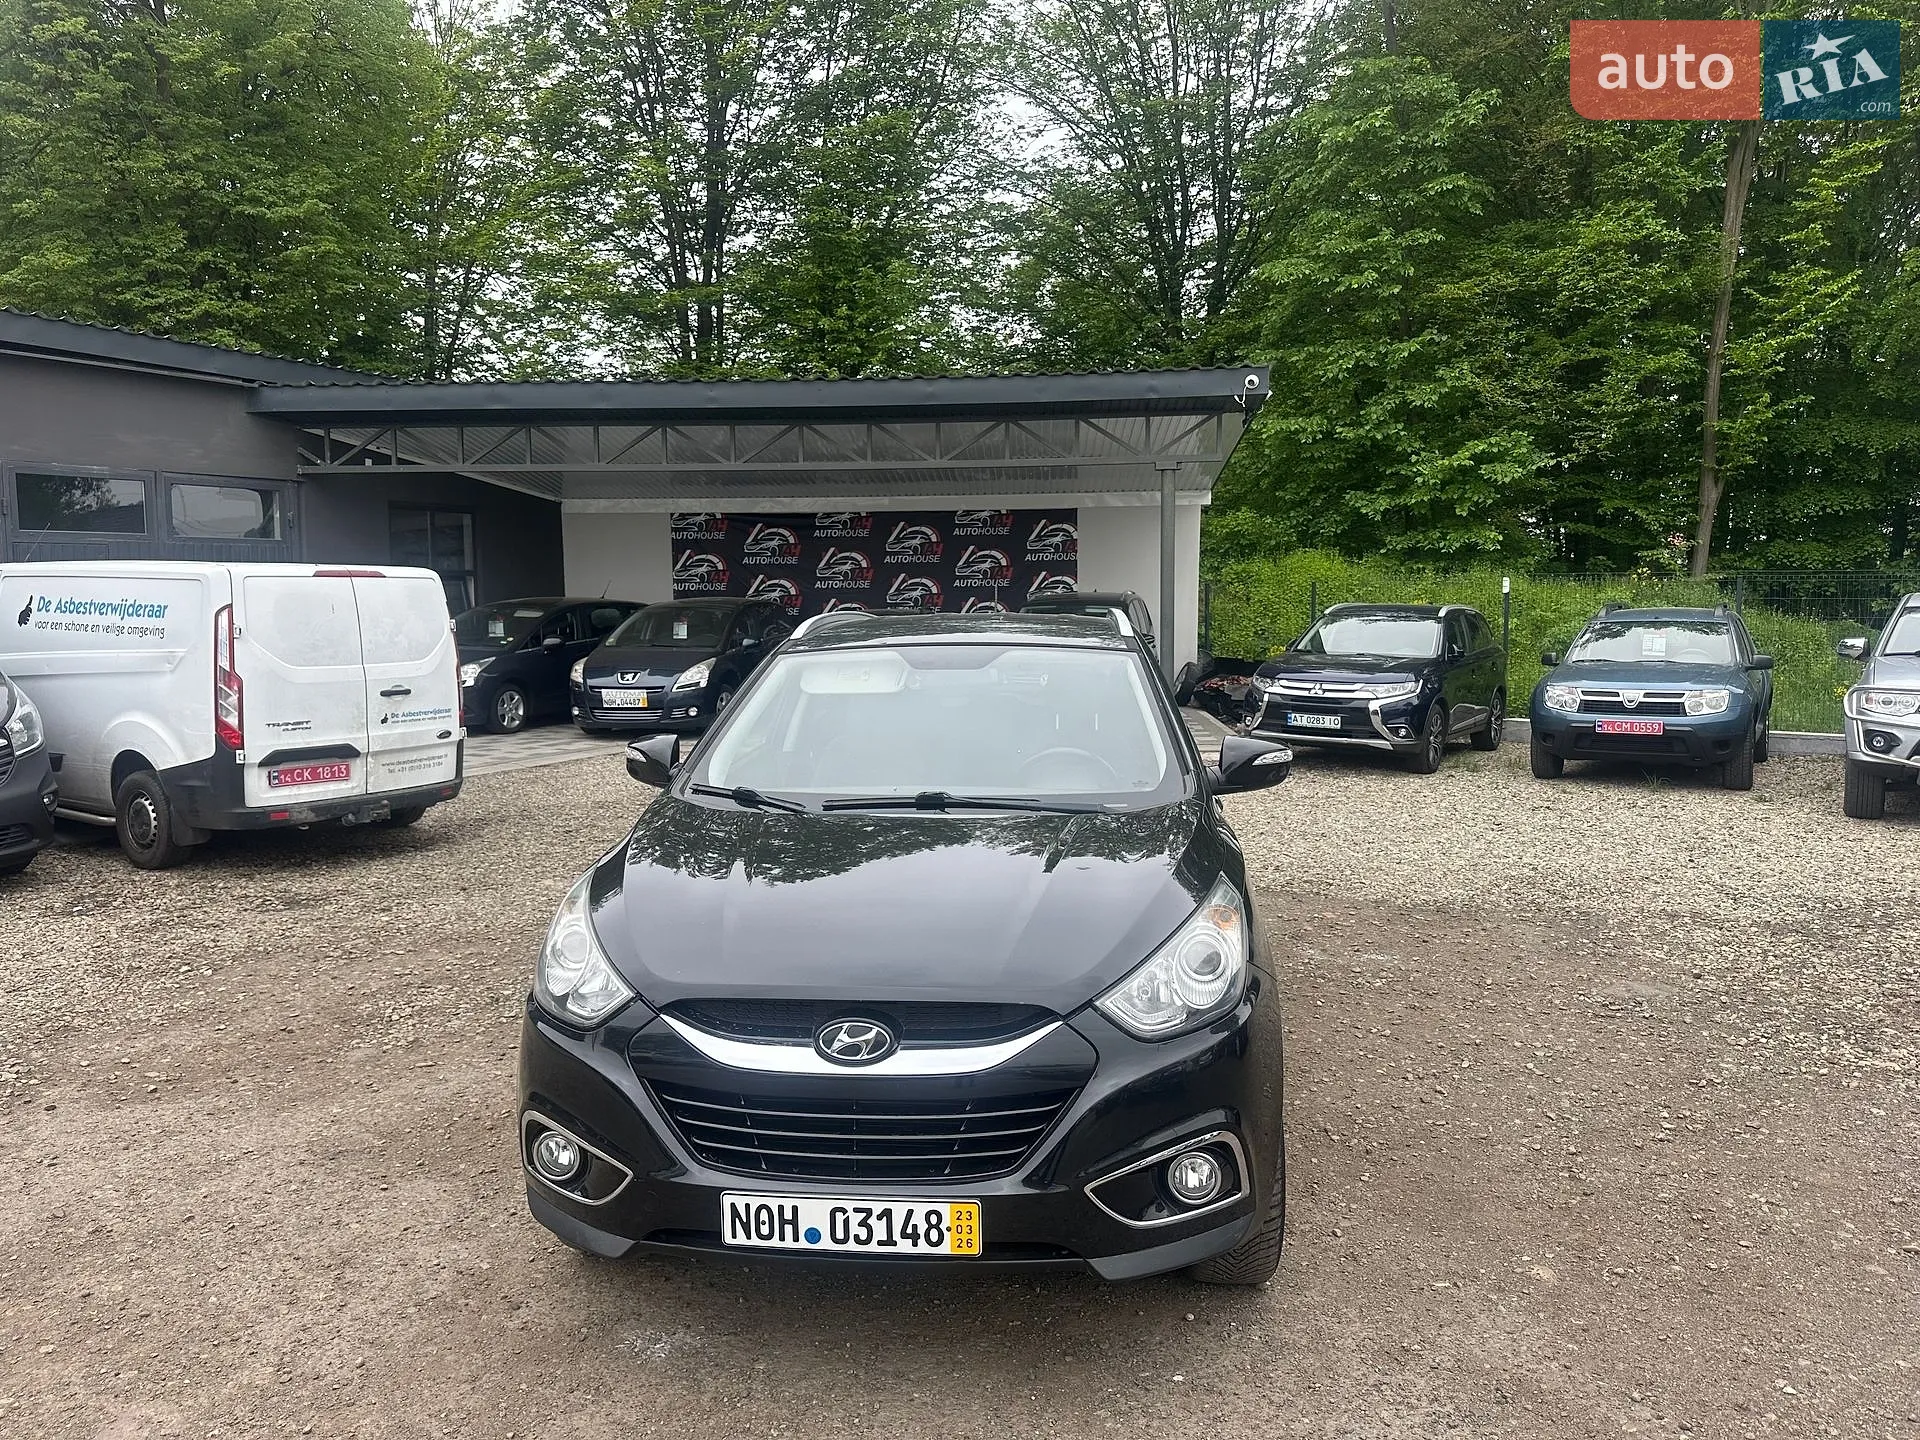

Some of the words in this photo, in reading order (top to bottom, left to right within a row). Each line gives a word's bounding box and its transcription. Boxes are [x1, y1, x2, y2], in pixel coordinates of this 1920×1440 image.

[813, 529, 870, 538] AUTOHOUSE
[953, 527, 1011, 536] AUTOHOUSE
[742, 556, 799, 565] AUTOHOUSE
[884, 555, 941, 564] AUTOHOUSE
[1024, 552, 1077, 562] AUTOHOUS
[673, 582, 727, 591] AUTOHOUSE
[814, 580, 871, 589] AUTOHOUSE
[953, 578, 1011, 588] AUTOHOUSE
[37, 596, 51, 613] De
[54, 597, 168, 621] Asbestverwijderaar
[34, 619, 50, 630] voor
[50, 621, 63, 631] een
[64, 620, 89, 633] schone
[90, 624, 100, 633] en
[101, 622, 125, 637] veilige
[127, 625, 165, 640] omgeving
[620, 698, 641, 706] 04487
[265, 720, 312, 728] TRANSIT
[1292, 715, 1304, 723] AT
[1306, 716, 1326, 725] 0283
[1604, 724, 1613, 732] 14
[1614, 722, 1631, 732] CM
[1633, 723, 1659, 733] 0559
[280, 774, 292, 783] 14
[294, 768, 312, 781] CK
[316, 765, 347, 779] 1813
[956, 1210, 973, 1221] 23
[730, 1202, 800, 1243] NOH
[829, 1206, 945, 1248] 03148
[956, 1224, 973, 1235] 03
[956, 1238, 973, 1249] 26
